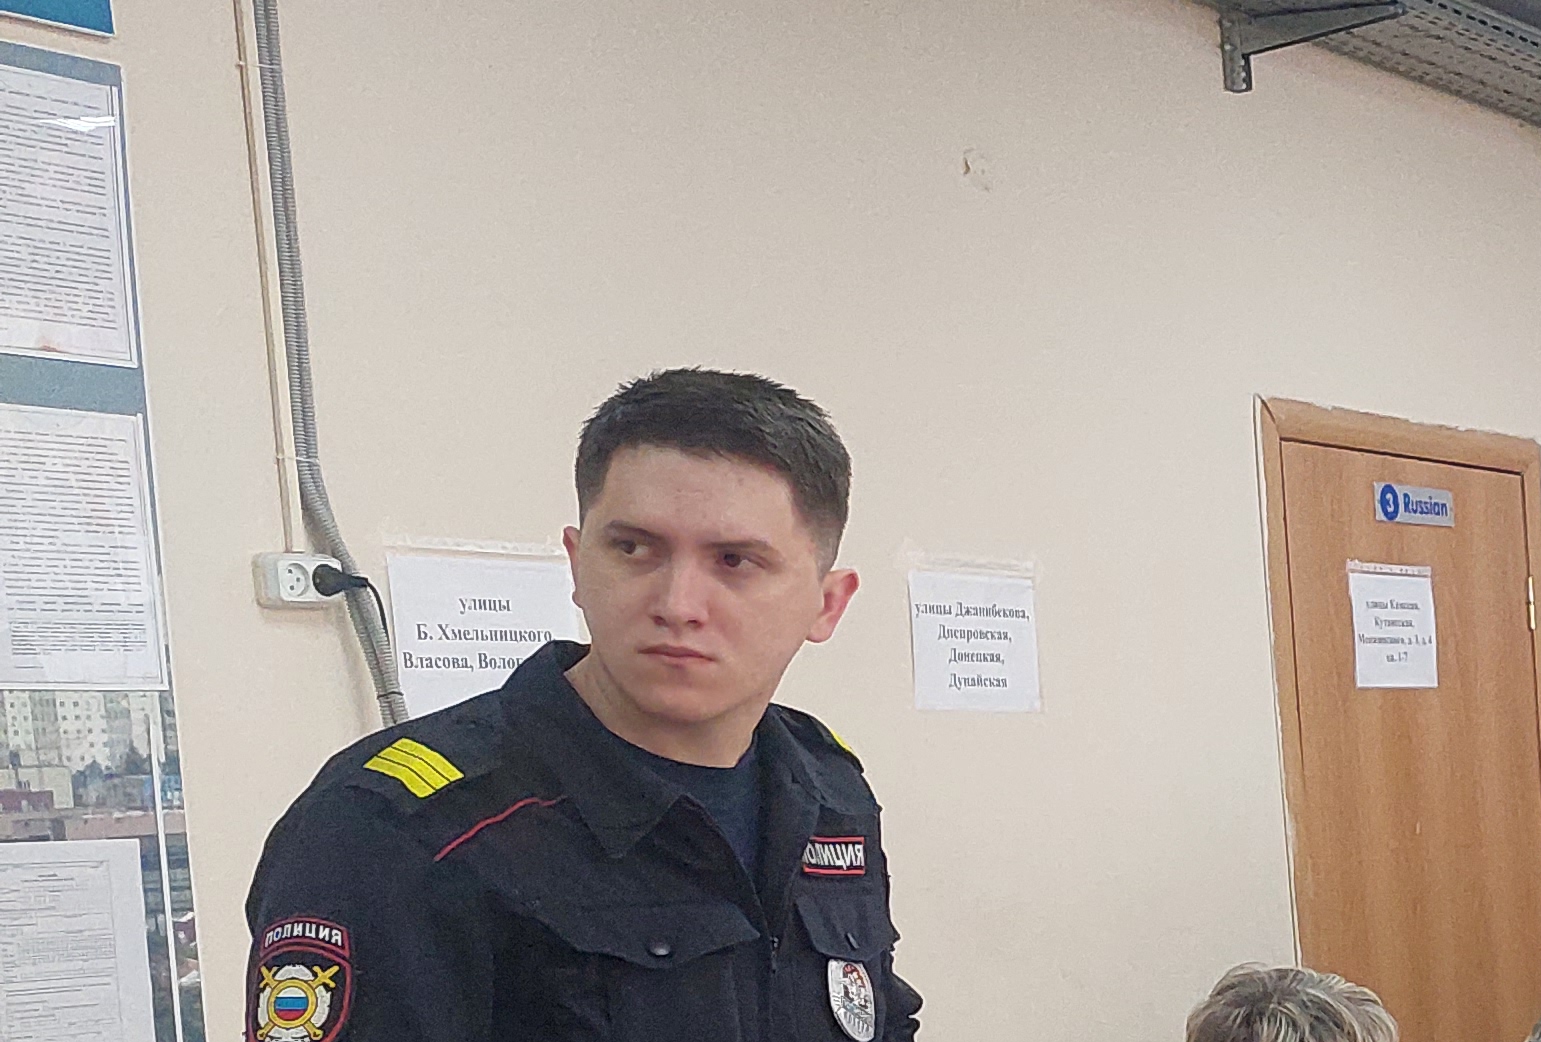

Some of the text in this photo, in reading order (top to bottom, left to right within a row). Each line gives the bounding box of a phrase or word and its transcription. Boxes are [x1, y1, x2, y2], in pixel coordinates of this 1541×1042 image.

[1386, 492, 1448, 517] 3 Russian
[458, 598, 512, 614] улицы
[914, 603, 952, 618] улицы
[416, 624, 433, 640] Б.
[938, 624, 1012, 643] Днепровская,
[402, 652, 474, 671] Власова,
[948, 648, 1005, 665] Донецкая,
[949, 673, 1008, 691] Дунайская
[264, 922, 343, 949] ПОЛИЦИЯ
